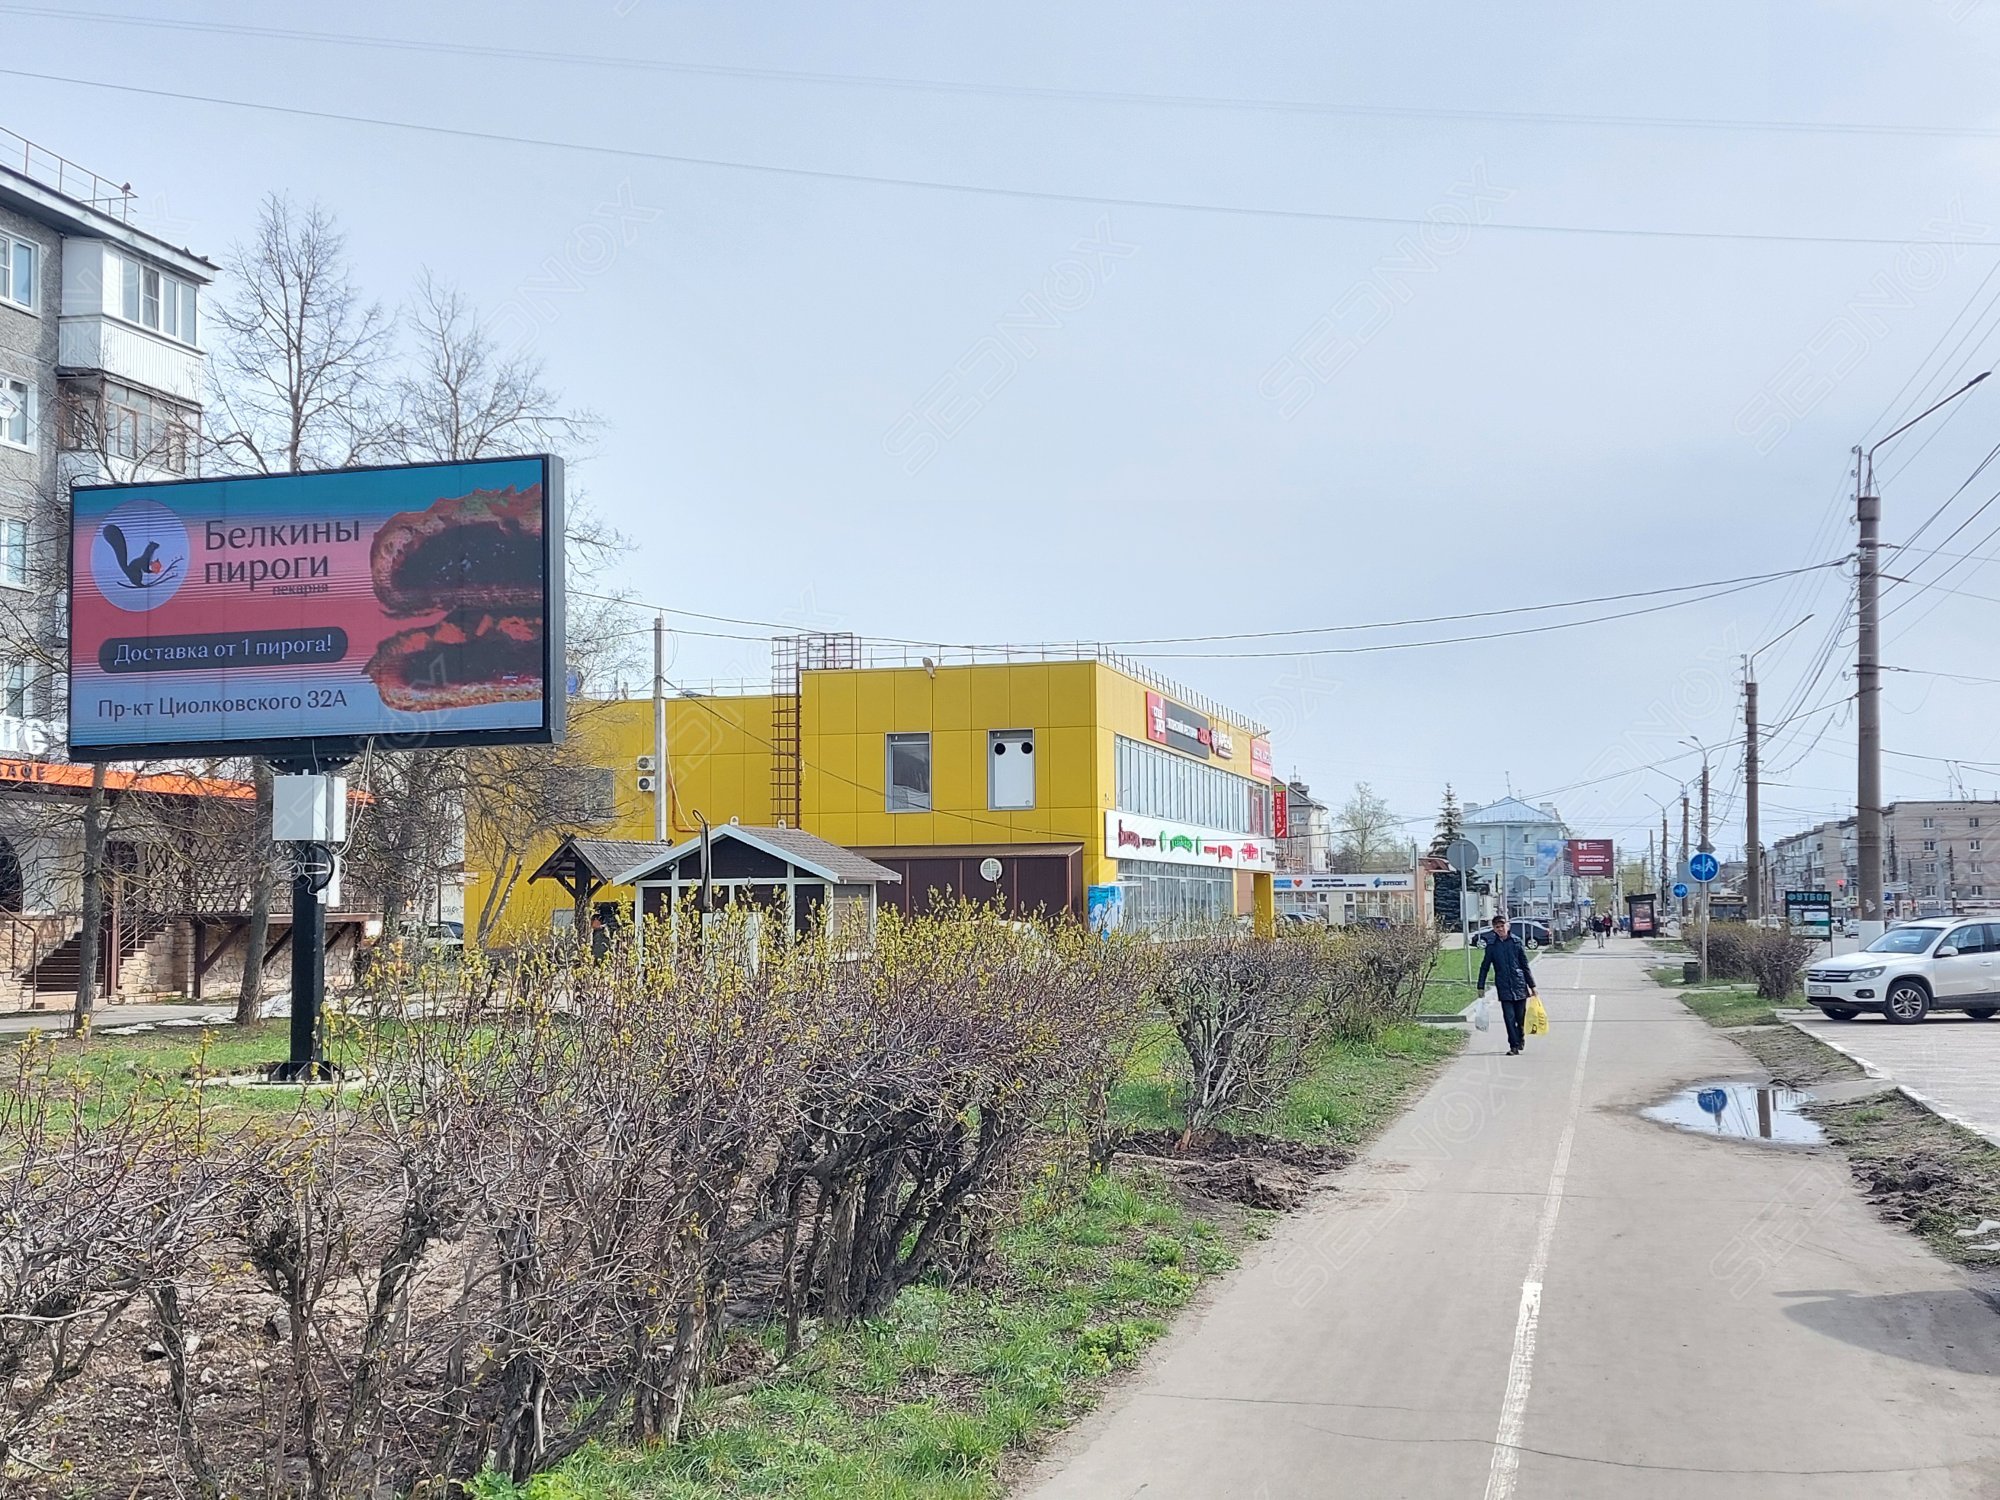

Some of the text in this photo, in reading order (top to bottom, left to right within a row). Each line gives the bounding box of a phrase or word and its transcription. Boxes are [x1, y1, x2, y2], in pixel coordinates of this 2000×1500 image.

[205, 519, 360, 551] Белкины
[204, 555, 329, 592] пироги
[272, 583, 329, 597] пекарня
[114, 633, 332, 666] Доставка от 1 пирога!
[98, 688, 348, 722] Пр-кт Циолковского 32А
[1382, 879, 1408, 887] smart
[1787, 893, 1830, 901] ФУТБОЛ
